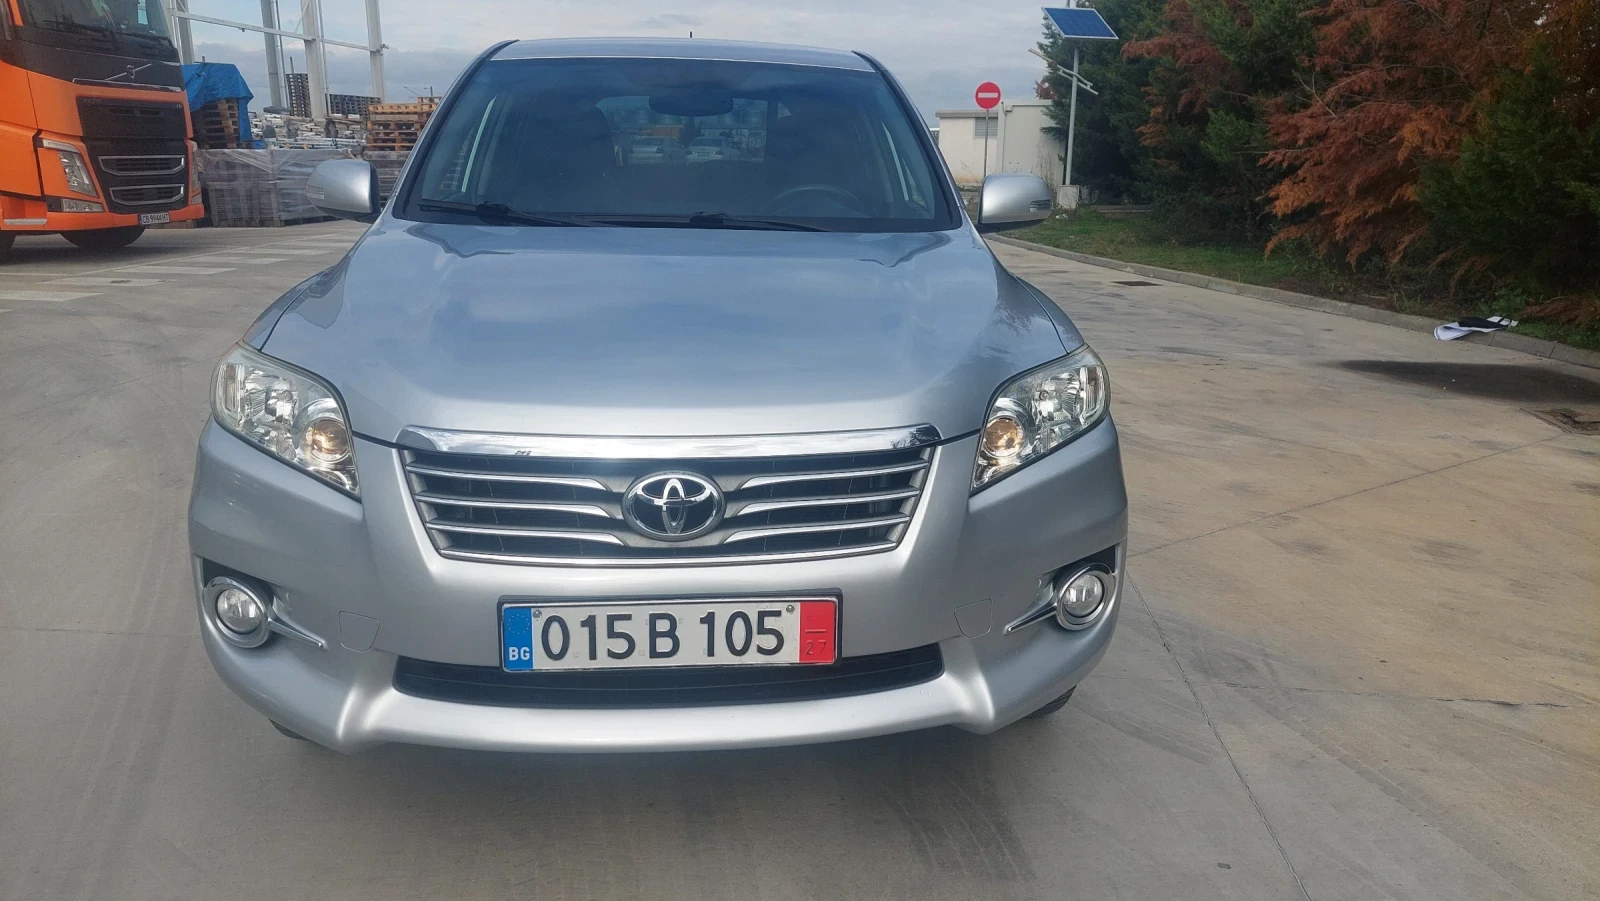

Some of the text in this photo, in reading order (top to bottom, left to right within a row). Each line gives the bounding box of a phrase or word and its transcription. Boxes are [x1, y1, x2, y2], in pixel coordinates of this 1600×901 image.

[541, 610, 785, 661] 015 B 105
[508, 646, 530, 661] BG
[806, 639, 826, 656] 27
